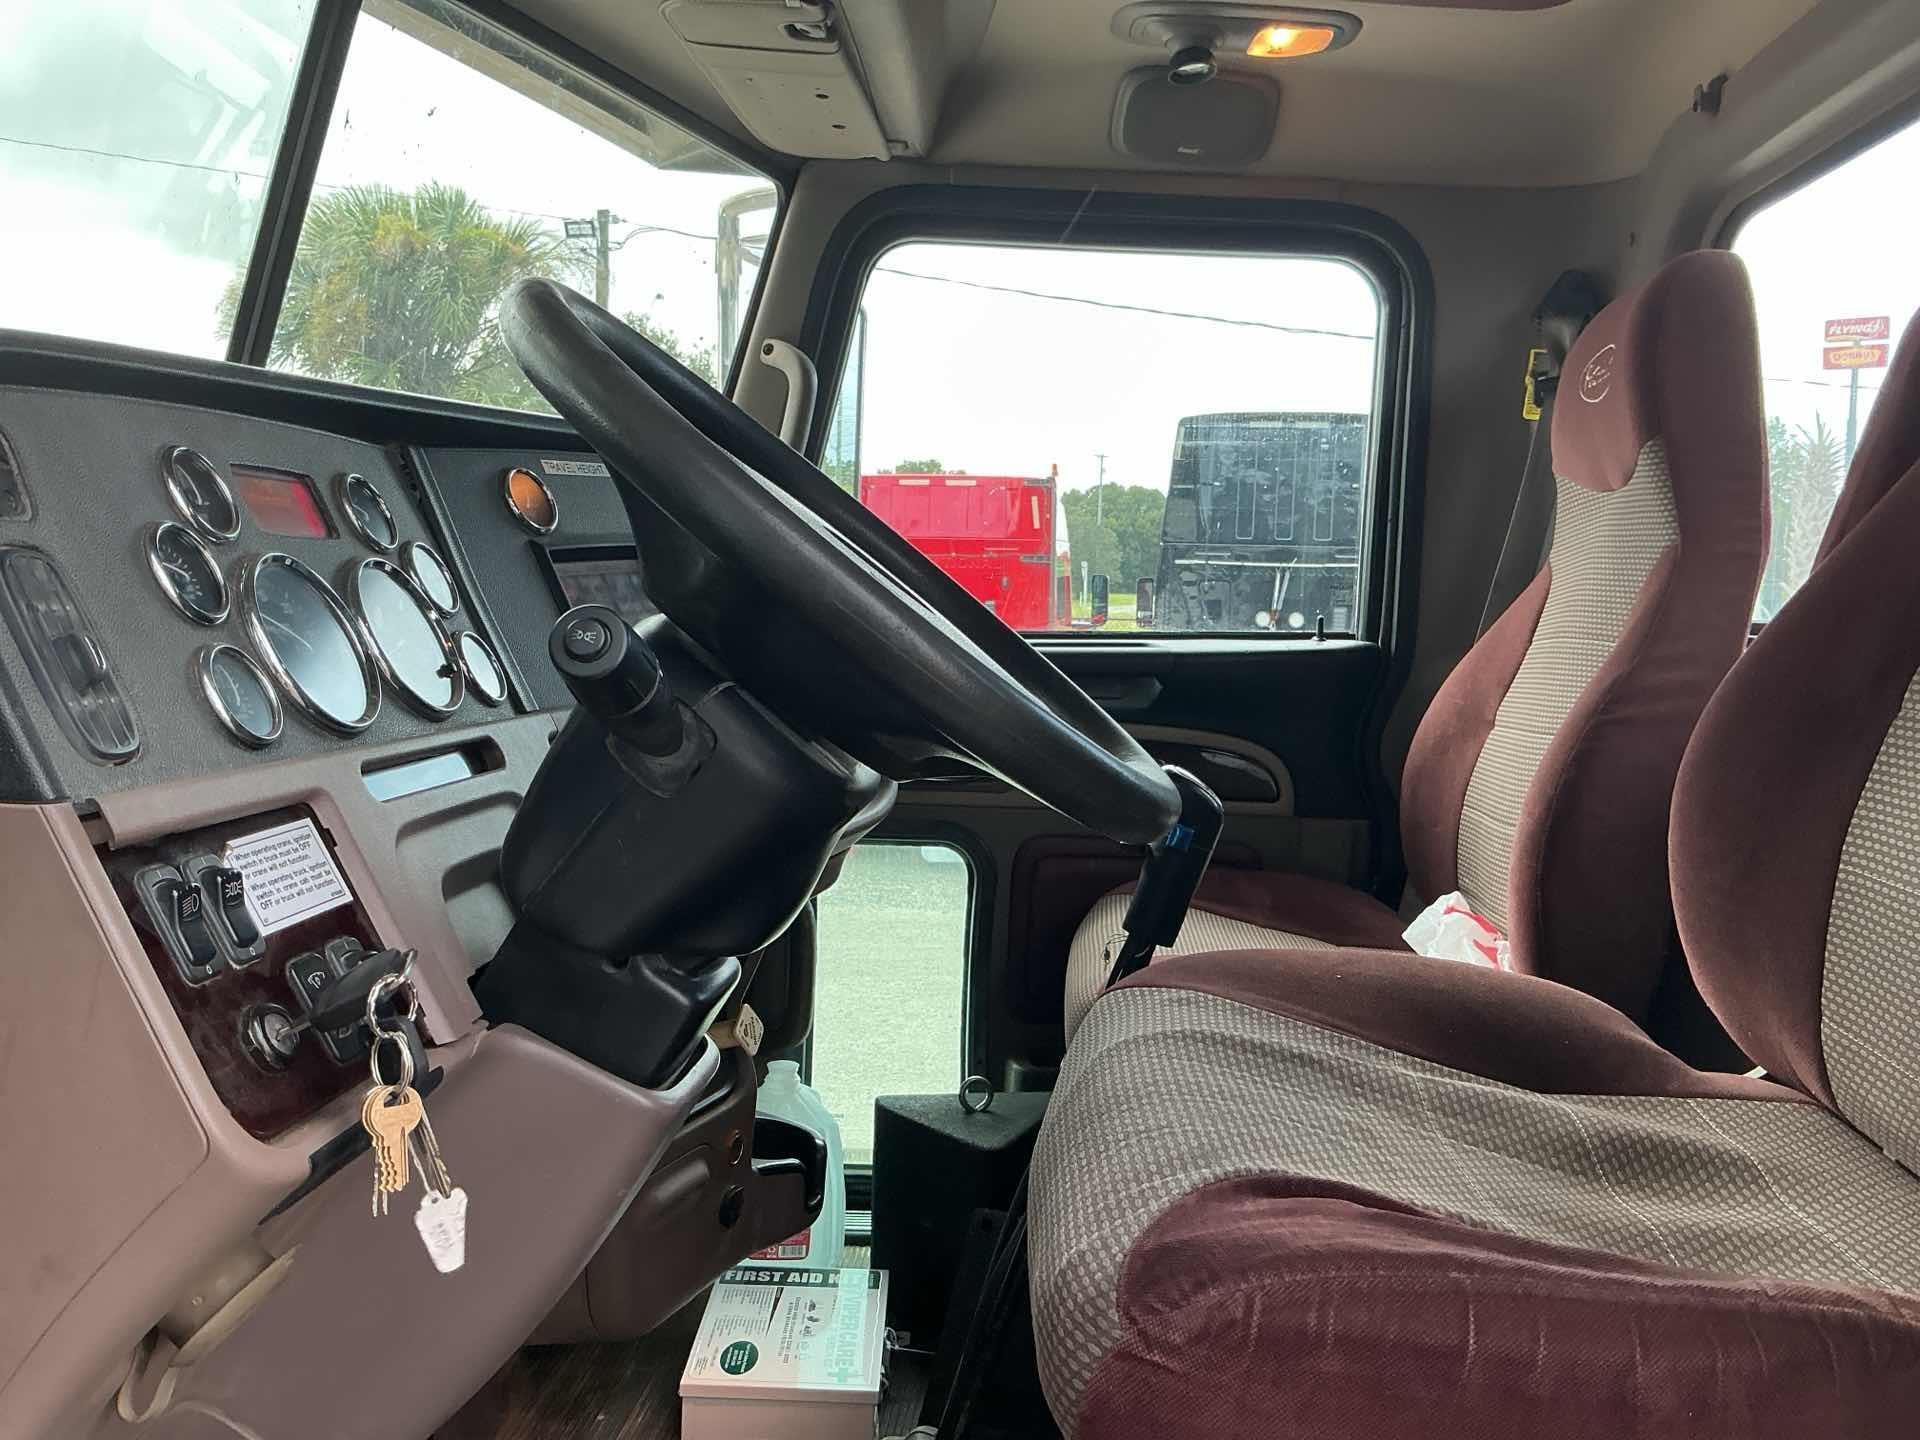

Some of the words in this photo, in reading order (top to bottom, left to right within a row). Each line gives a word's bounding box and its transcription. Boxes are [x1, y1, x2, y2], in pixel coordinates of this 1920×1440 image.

[543, 461, 575, 473] TRAVEL
[576, 462, 606, 475] HEIGHT
[234, 851, 251, 861] When
[250, 843, 277, 858] operating
[292, 833, 312, 844] ignition
[239, 860, 258, 870] switch
[263, 853, 278, 862] truck
[278, 849, 292, 857] must
[298, 841, 312, 850] OFF
[250, 881, 267, 891] When
[267, 872, 293, 887] operating
[308, 860, 327, 872] ignition
[277, 860, 288, 868] not
[255, 889, 274, 901] switch
[309, 872, 323, 881] must
[259, 898, 273, 910] OFF
[280, 892, 295, 902] truck
[294, 888, 305, 896] will
[724, 1270, 785, 1283] FIRST
[786, 1271, 823, 1284] AID
